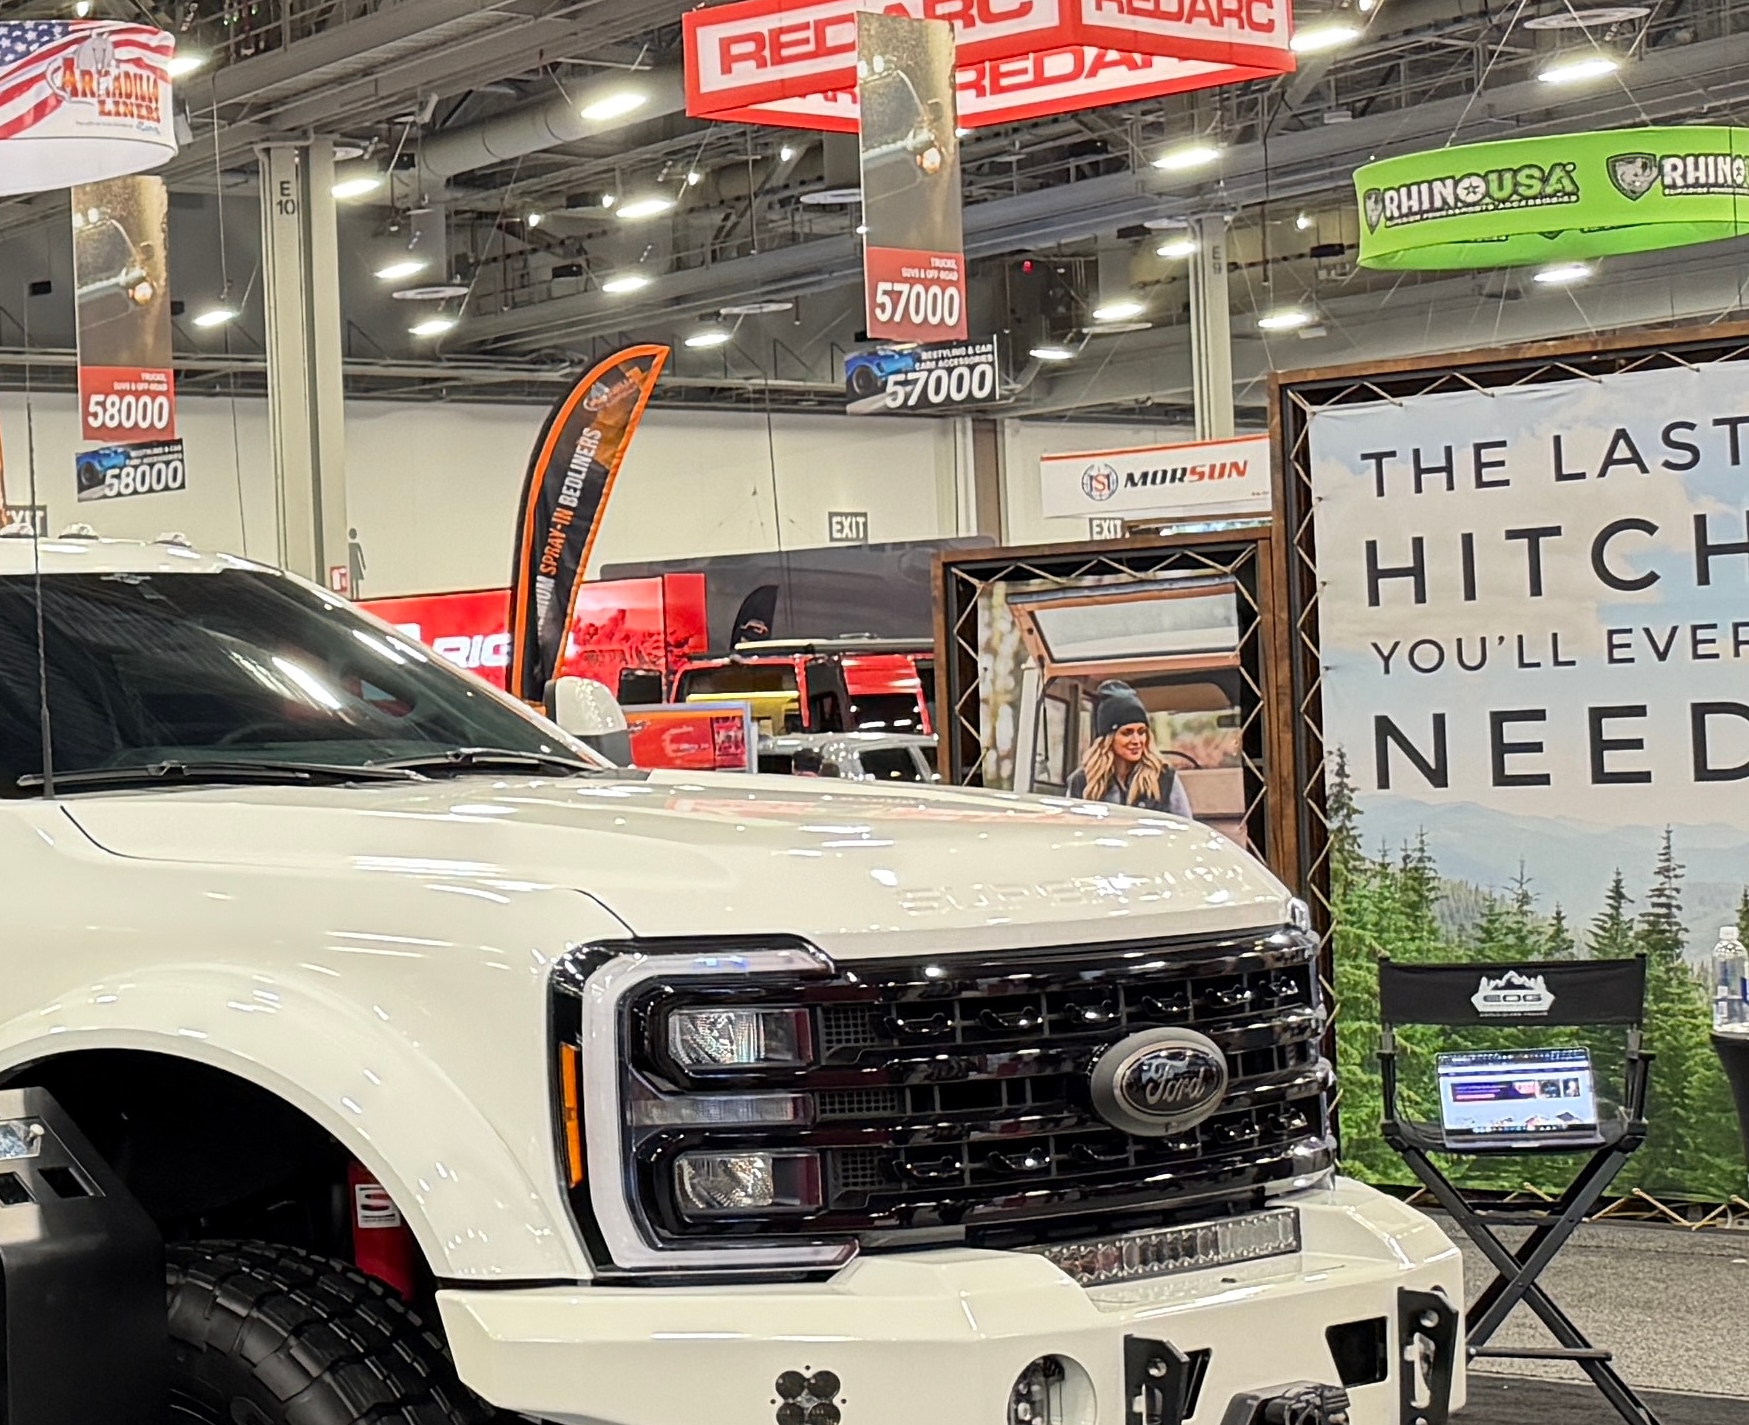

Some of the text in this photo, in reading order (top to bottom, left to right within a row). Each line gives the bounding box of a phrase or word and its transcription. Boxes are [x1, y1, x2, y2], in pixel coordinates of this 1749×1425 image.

[280, 181, 291, 196] E
[1662, 156, 1749, 187] RHINO
[276, 199, 296, 215] 10
[1212, 246, 1221, 260] E
[875, 282, 960, 328] 57000
[885, 363, 993, 409] 57000
[87, 394, 170, 430] 58000
[1124, 460, 1248, 489] MORSUN
[1361, 417, 1749, 498] THE LAST
[104, 459, 183, 497] 58000
[540, 507, 574, 576] SPRAY-IN
[558, 426, 602, 508] BEDLINERS
[5, 510, 44, 535] XIT
[831, 516, 865, 539] EXIT
[1092, 519, 1122, 539] EXIT
[1365, 513, 1749, 607] HITCH
[1371, 631, 1577, 676] YOU'LL
[1374, 701, 1749, 791] NEED
[1145, 1059, 1206, 1105] Ford
